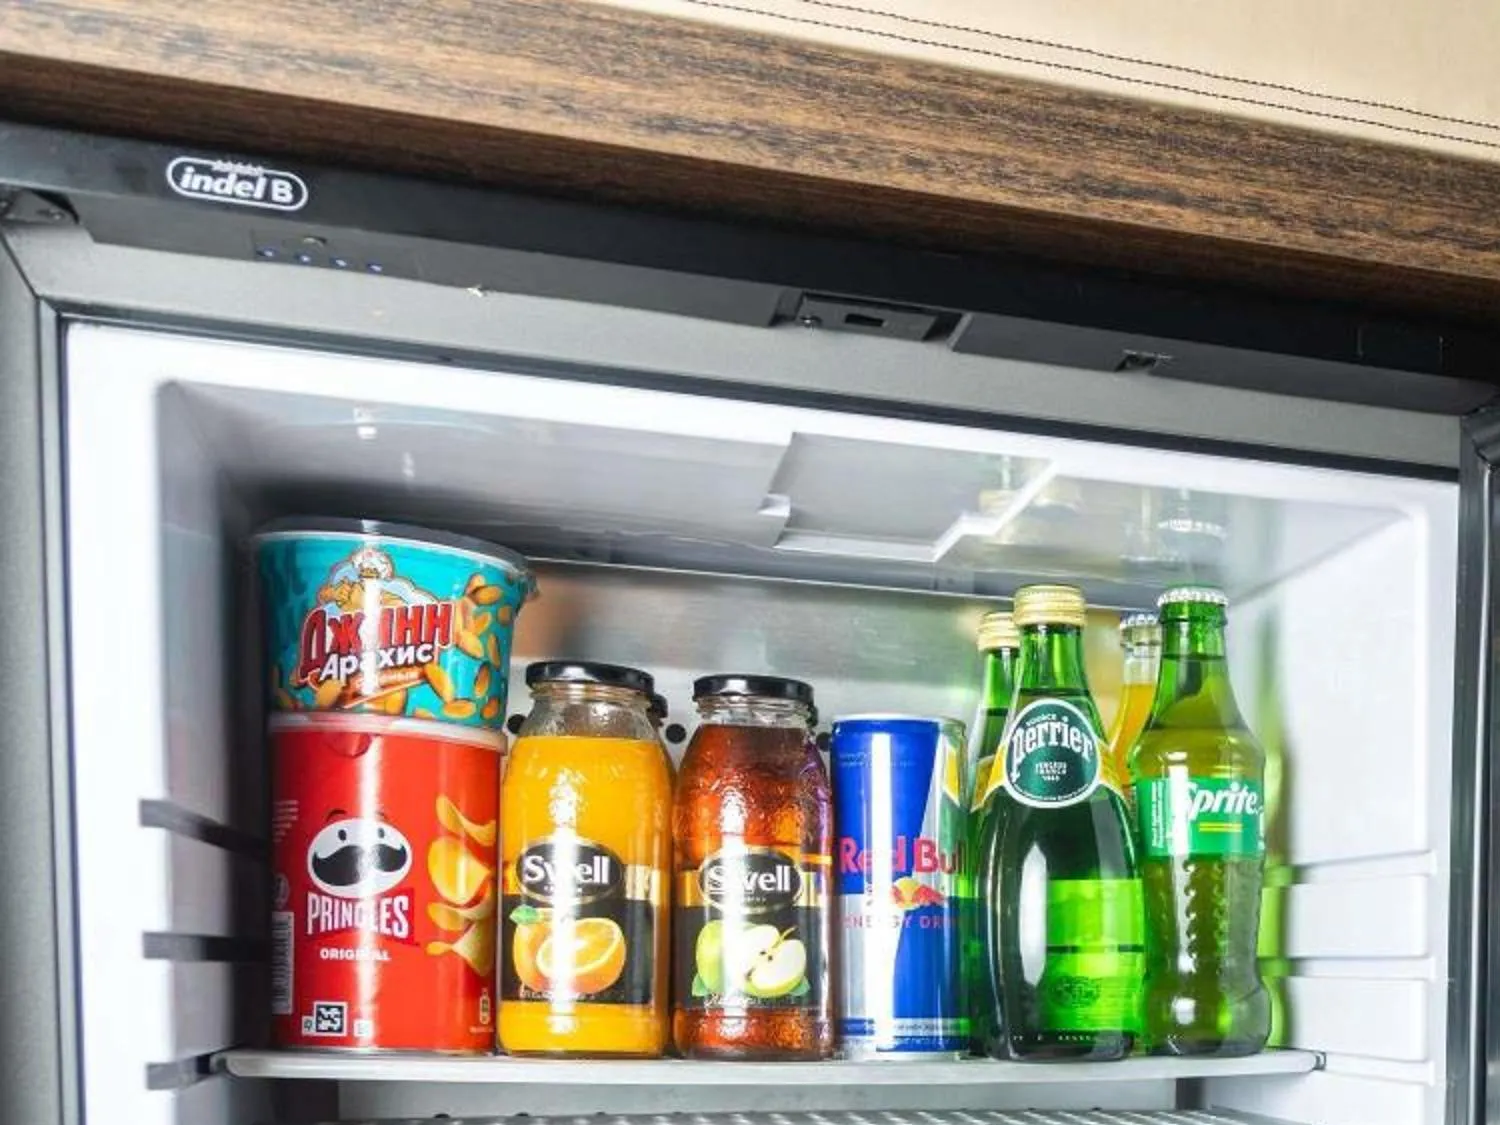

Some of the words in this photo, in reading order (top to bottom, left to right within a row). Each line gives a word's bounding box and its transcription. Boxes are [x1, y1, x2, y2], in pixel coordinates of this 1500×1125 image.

[179, 165, 268, 200] indel
[271, 178, 294, 203] B
[319, 643, 433, 681] Архис
[523, 855, 610, 885] Sell
